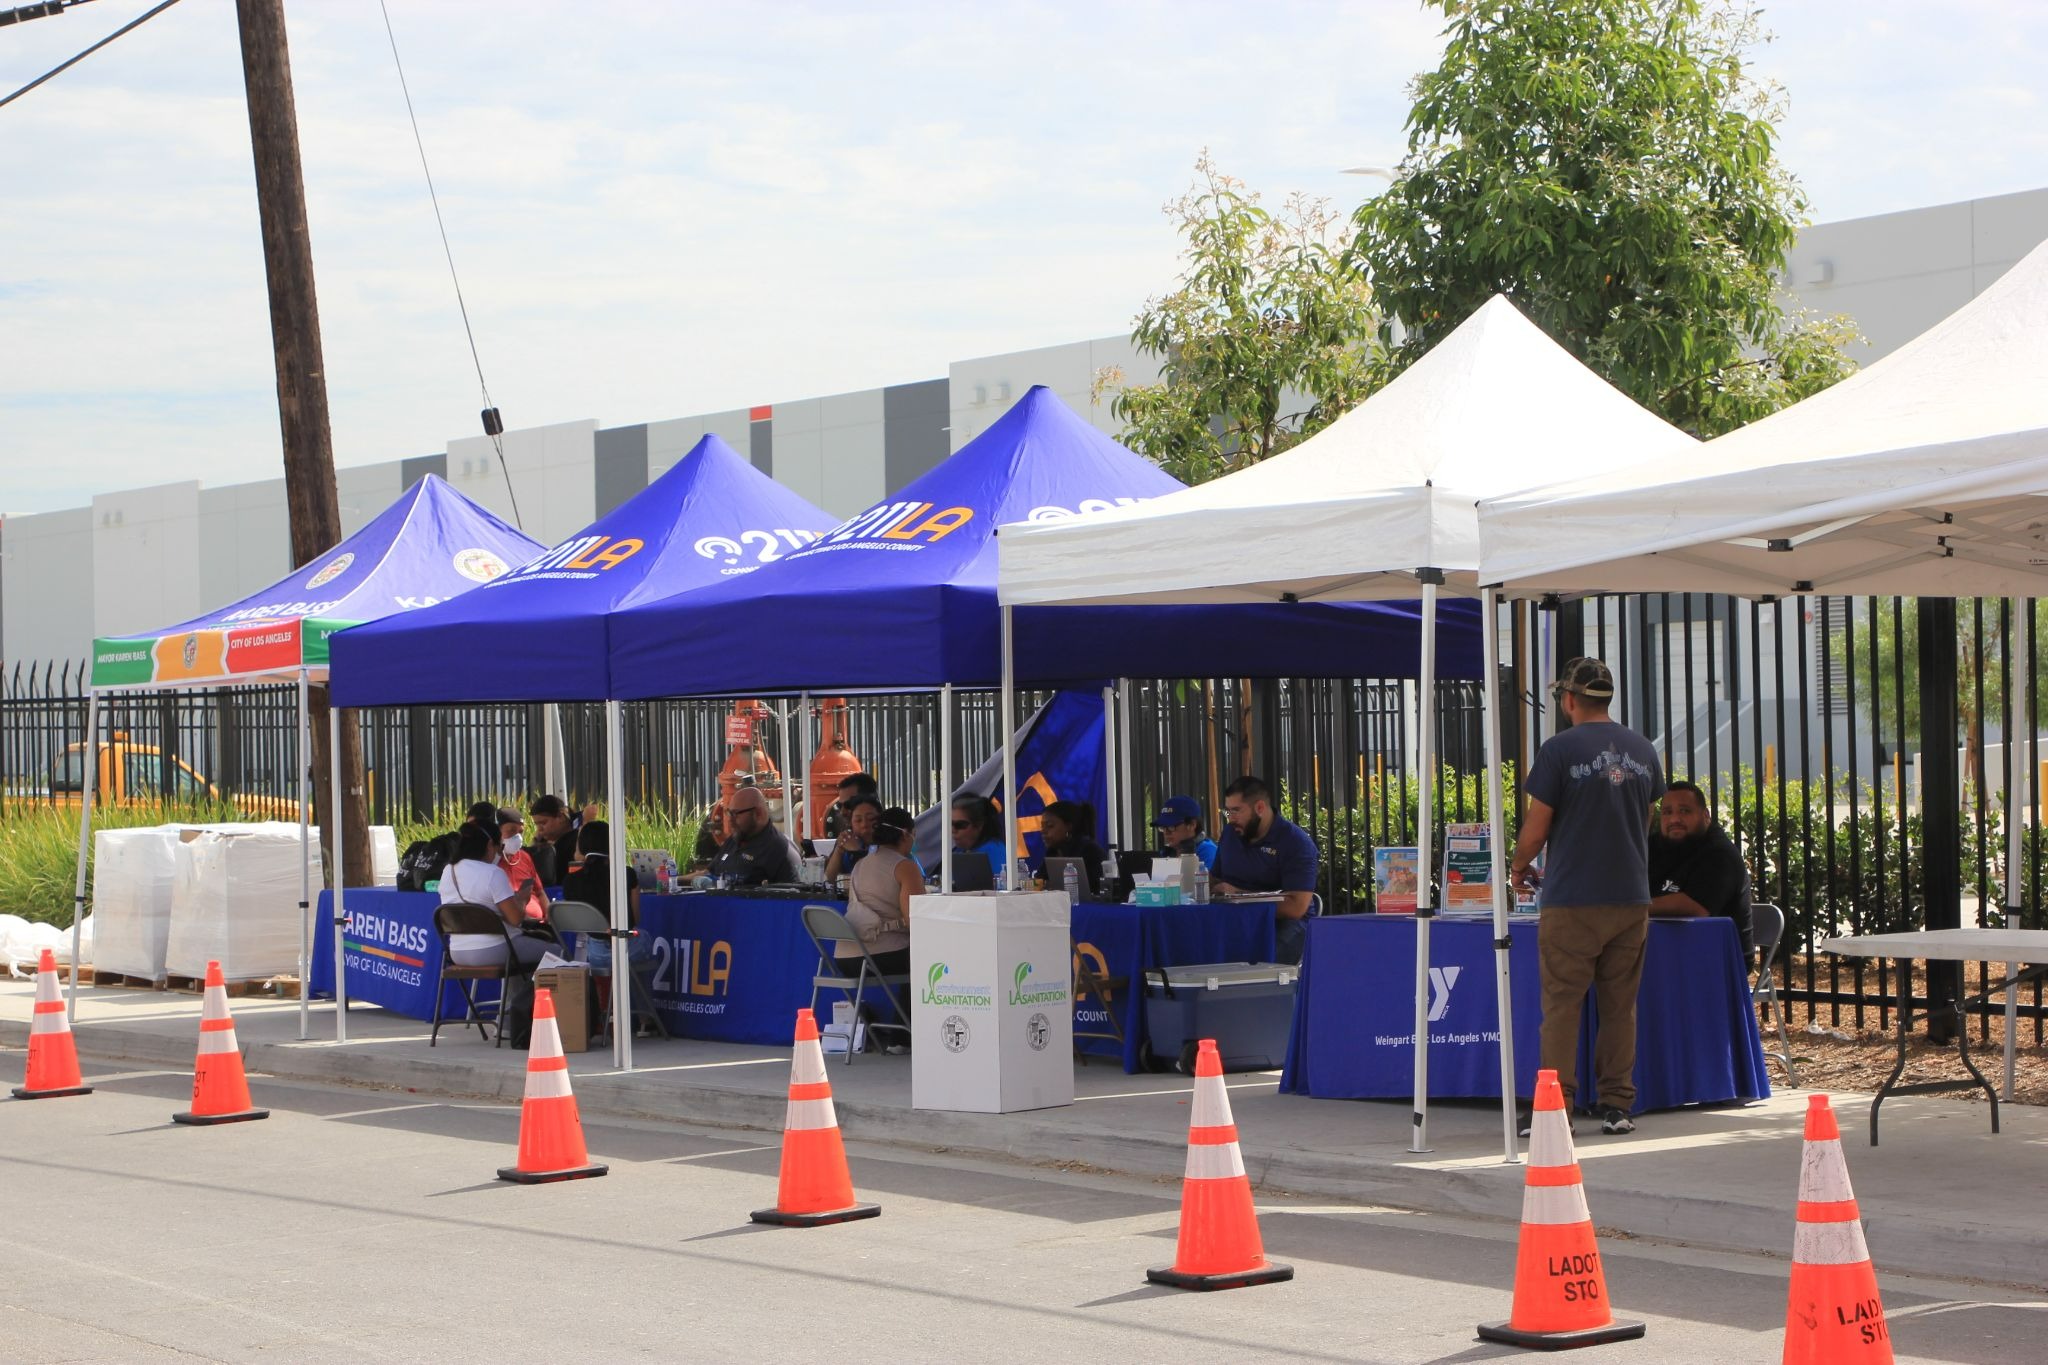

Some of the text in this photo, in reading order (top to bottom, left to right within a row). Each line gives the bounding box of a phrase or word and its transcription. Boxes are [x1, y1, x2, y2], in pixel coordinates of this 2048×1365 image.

[848, 541, 888, 551] ANGELES
[887, 542, 926, 552] COUNTY
[230, 631, 292, 649] CITY OF LOS ANGELES
[132, 650, 147, 661] BASS
[388, 920, 428, 953] BASS
[360, 958, 372, 972] OF
[372, 961, 387, 977] LOS
[388, 966, 422, 987] ANGELES
[652, 936, 732, 996] 211LA
[1076, 1010, 1108, 1022] COUNT
[1375, 1034, 1410, 1048] Weingart
[1431, 1034, 1446, 1044] Los
[1447, 1033, 1480, 1046] Angeles
[1482, 1032, 1501, 1042] YMC
[1549, 1252, 1599, 1276] LADOT
[1564, 1279, 1598, 1301] STO
